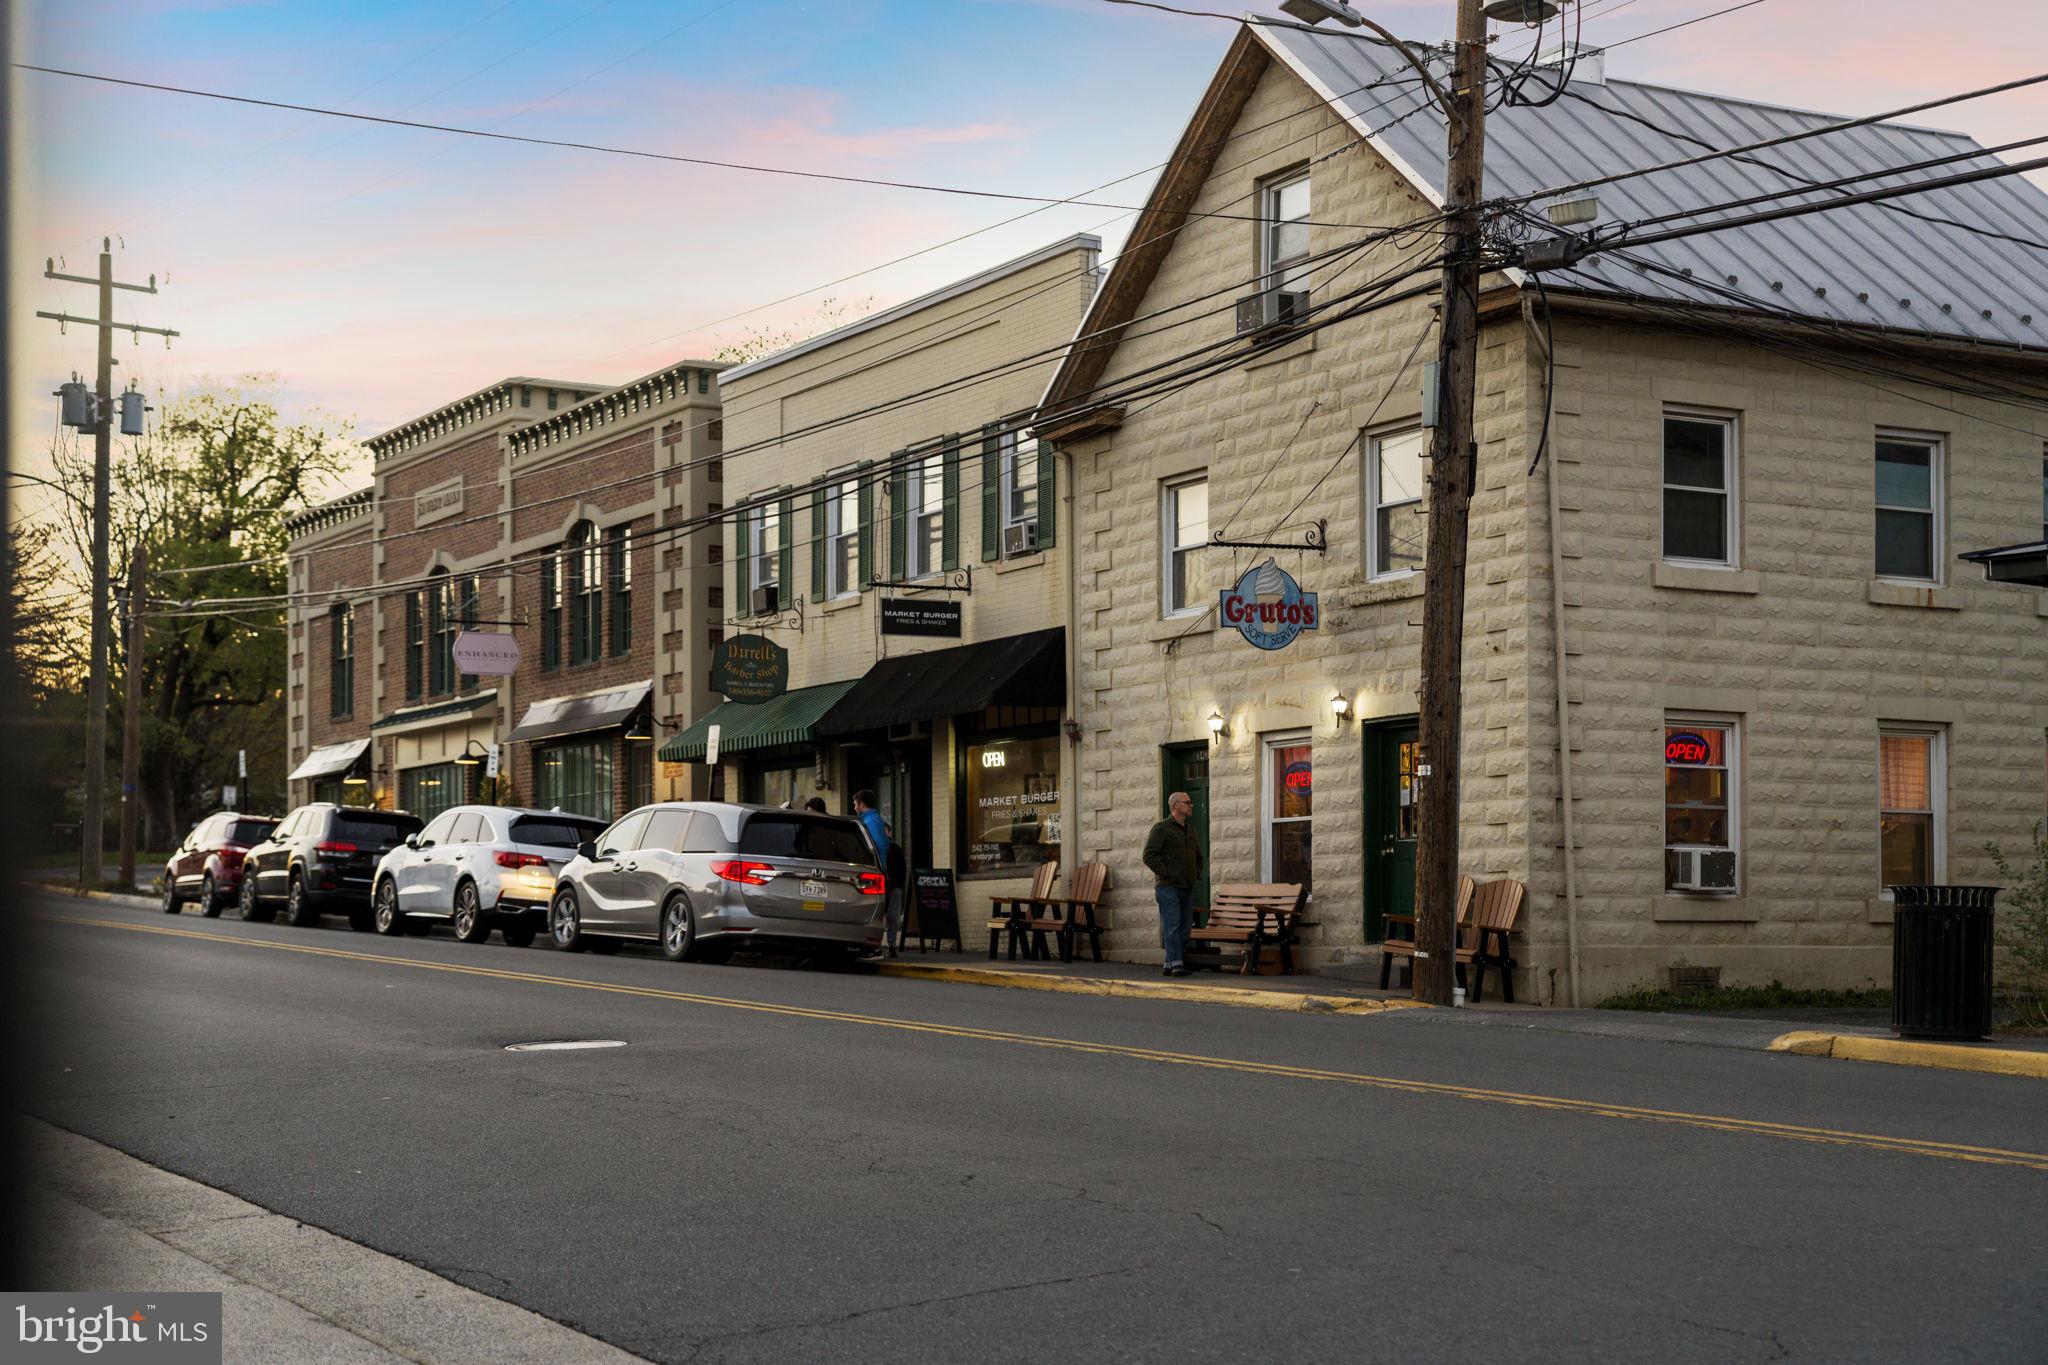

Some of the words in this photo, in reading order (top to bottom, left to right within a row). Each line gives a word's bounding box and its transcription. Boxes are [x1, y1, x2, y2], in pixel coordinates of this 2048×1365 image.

[884, 610, 920, 618] MARKET
[1225, 595, 1315, 624] Gruto's
[1245, 624, 1267, 644] SOFT
[1271, 624, 1297, 646] SERVE
[457, 650, 518, 659] ENHANCED
[729, 644, 776, 661] Darrell's
[724, 661, 753, 679] Barber
[757, 664, 778, 679] Shop
[982, 752, 1005, 767] OPEN
[1666, 743, 1706, 760] OPEN
[979, 795, 1017, 807] MARKET
[1021, 791, 1060, 804] BURGER
[991, 809, 1011, 819] FRIES
[1018, 806, 1047, 818] SHAKES
